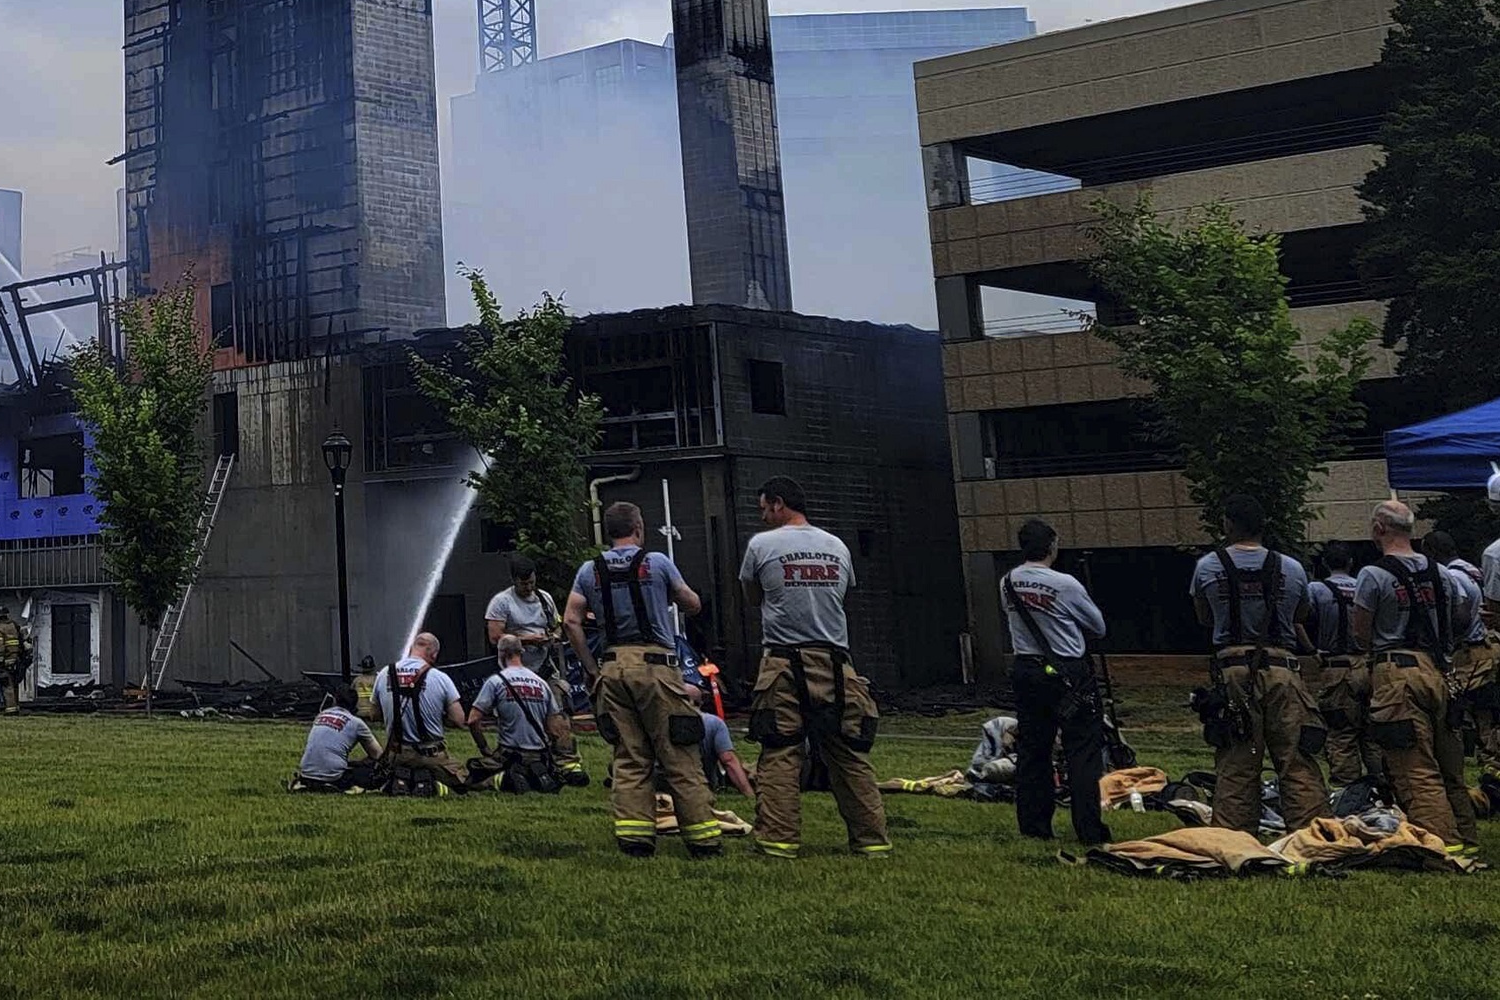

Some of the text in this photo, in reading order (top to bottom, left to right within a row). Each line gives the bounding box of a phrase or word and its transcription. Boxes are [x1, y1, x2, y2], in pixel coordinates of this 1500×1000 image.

[779, 552, 840, 564] CHARLOTTE
[783, 564, 840, 580] FIRE
[1002, 581, 1060, 598] CARLOTTE
